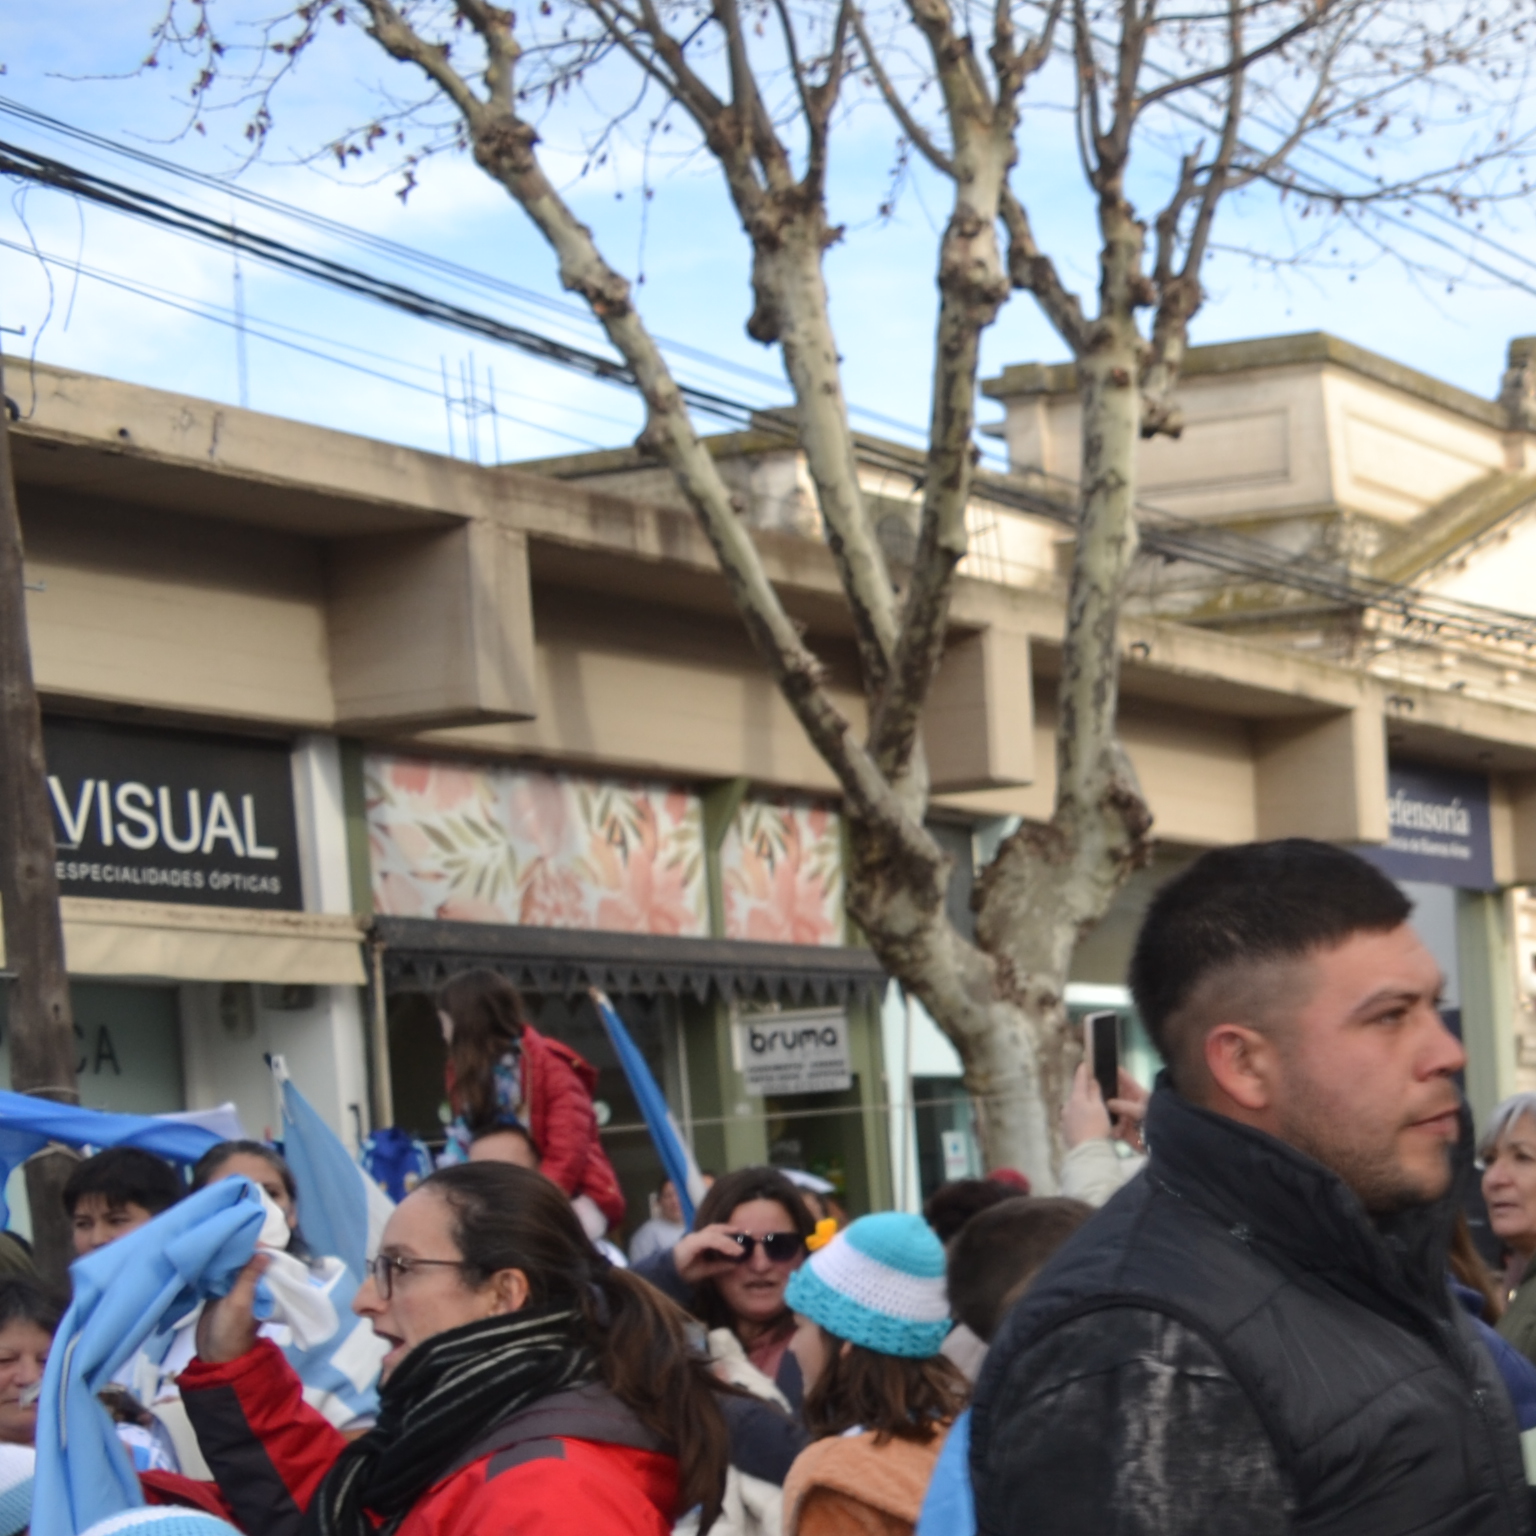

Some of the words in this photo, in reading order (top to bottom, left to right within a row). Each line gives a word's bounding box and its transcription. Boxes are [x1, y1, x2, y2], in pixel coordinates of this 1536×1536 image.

[47, 775, 280, 860] VISUAL
[56, 861, 204, 888] ESPECIALIDADES
[209, 869, 283, 895] ÓPTICAS
[749, 1025, 838, 1054] bruma
